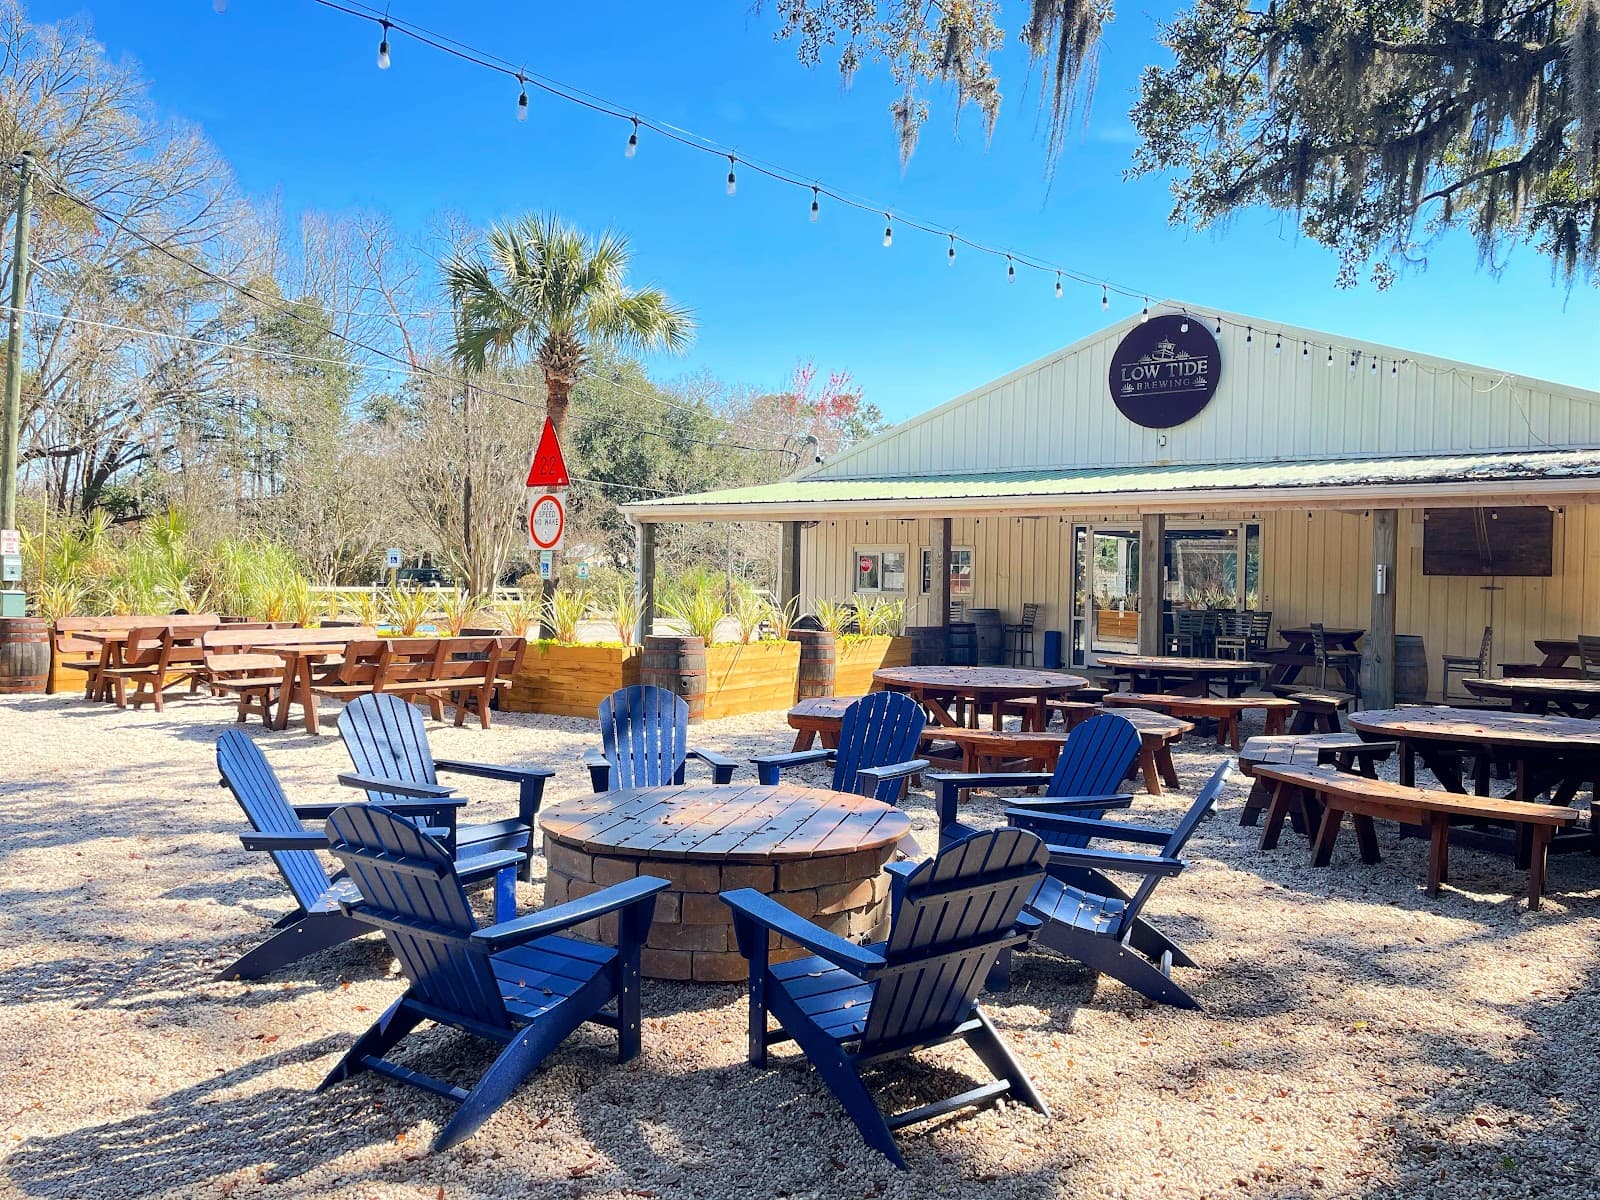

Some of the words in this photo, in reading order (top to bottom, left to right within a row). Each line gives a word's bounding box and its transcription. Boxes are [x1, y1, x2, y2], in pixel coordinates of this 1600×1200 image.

[1121, 365, 1160, 381] LOW
[1166, 360, 1208, 377] TIDE
[1137, 379, 1190, 391] BREWING
[540, 456, 556, 475] 22
